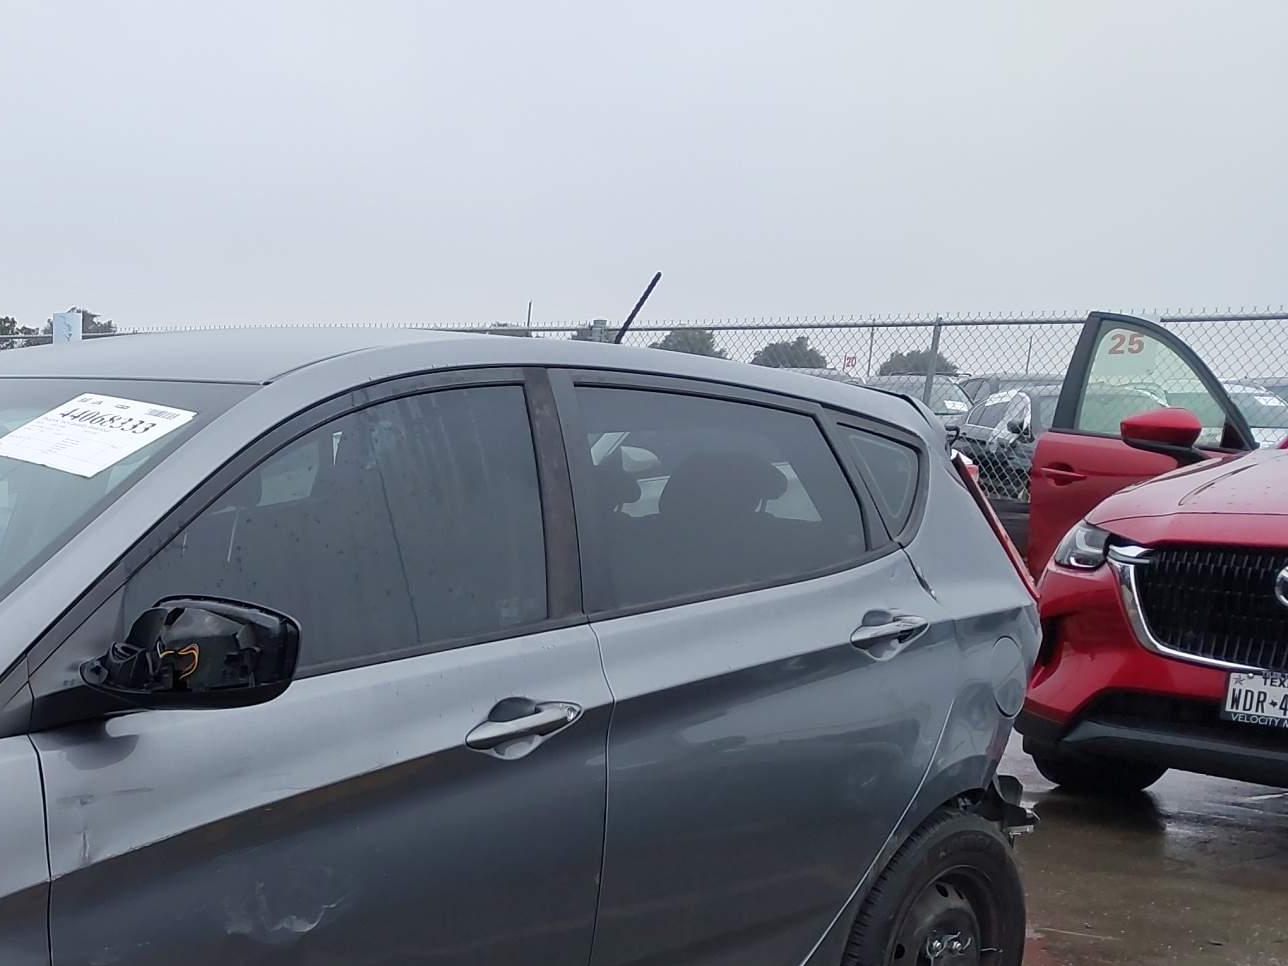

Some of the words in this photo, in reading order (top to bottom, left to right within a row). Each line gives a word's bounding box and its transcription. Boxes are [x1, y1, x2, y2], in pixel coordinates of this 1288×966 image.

[1108, 332, 1145, 355] 25
[60, 407, 156, 434] 44068333
[1231, 712, 1280, 727] VELOCITY
